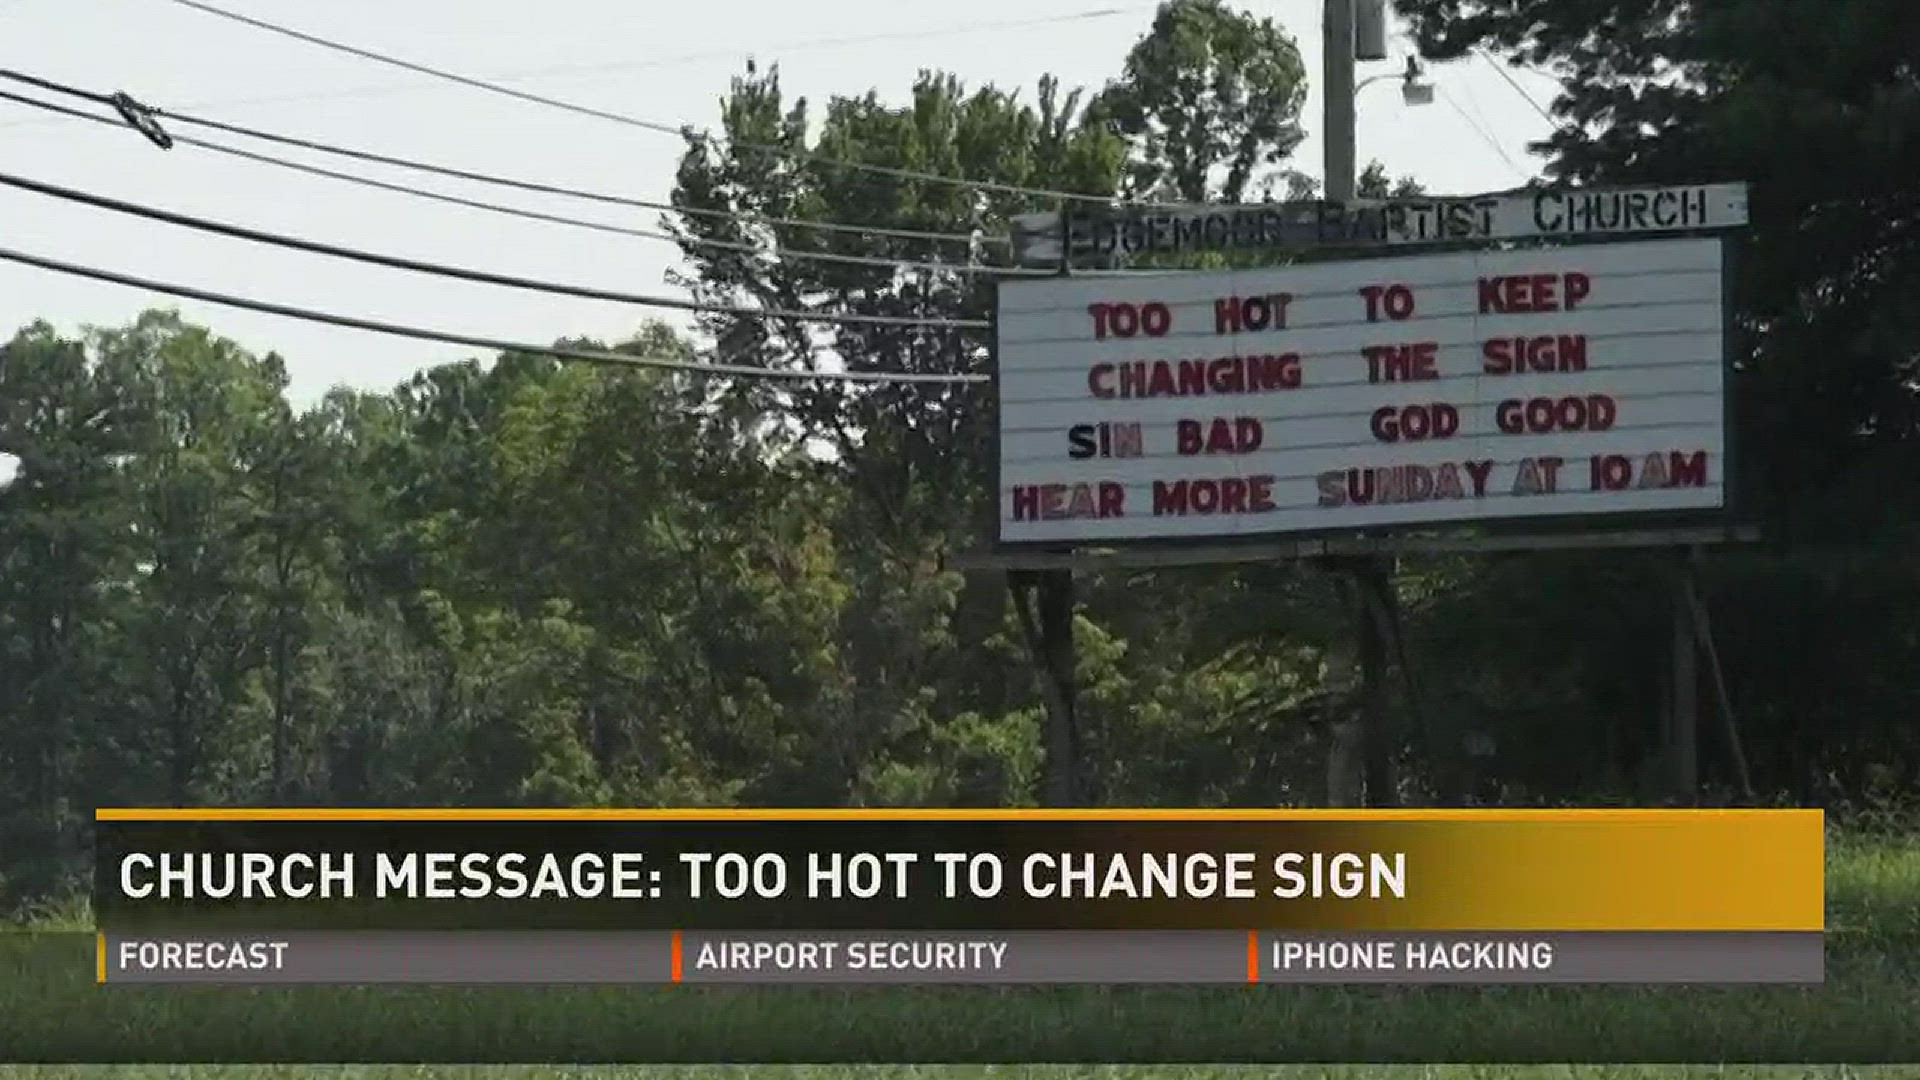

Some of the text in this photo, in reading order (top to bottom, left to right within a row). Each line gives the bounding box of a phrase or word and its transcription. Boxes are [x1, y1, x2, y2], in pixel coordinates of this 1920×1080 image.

[1534, 189, 1706, 232] CHURCH
[1088, 272, 1590, 340] TOO HOT TO KEEP
[1088, 335, 1587, 398] CHANGING THE SIGN
[1069, 395, 1616, 458] SIN BAD GOD GOOD
[1012, 482, 1125, 521] HEAR
[1153, 475, 1276, 516] MORE
[1317, 459, 1494, 506] SUNDAY
[1512, 457, 1563, 497] AT
[1638, 450, 1706, 489] AM
